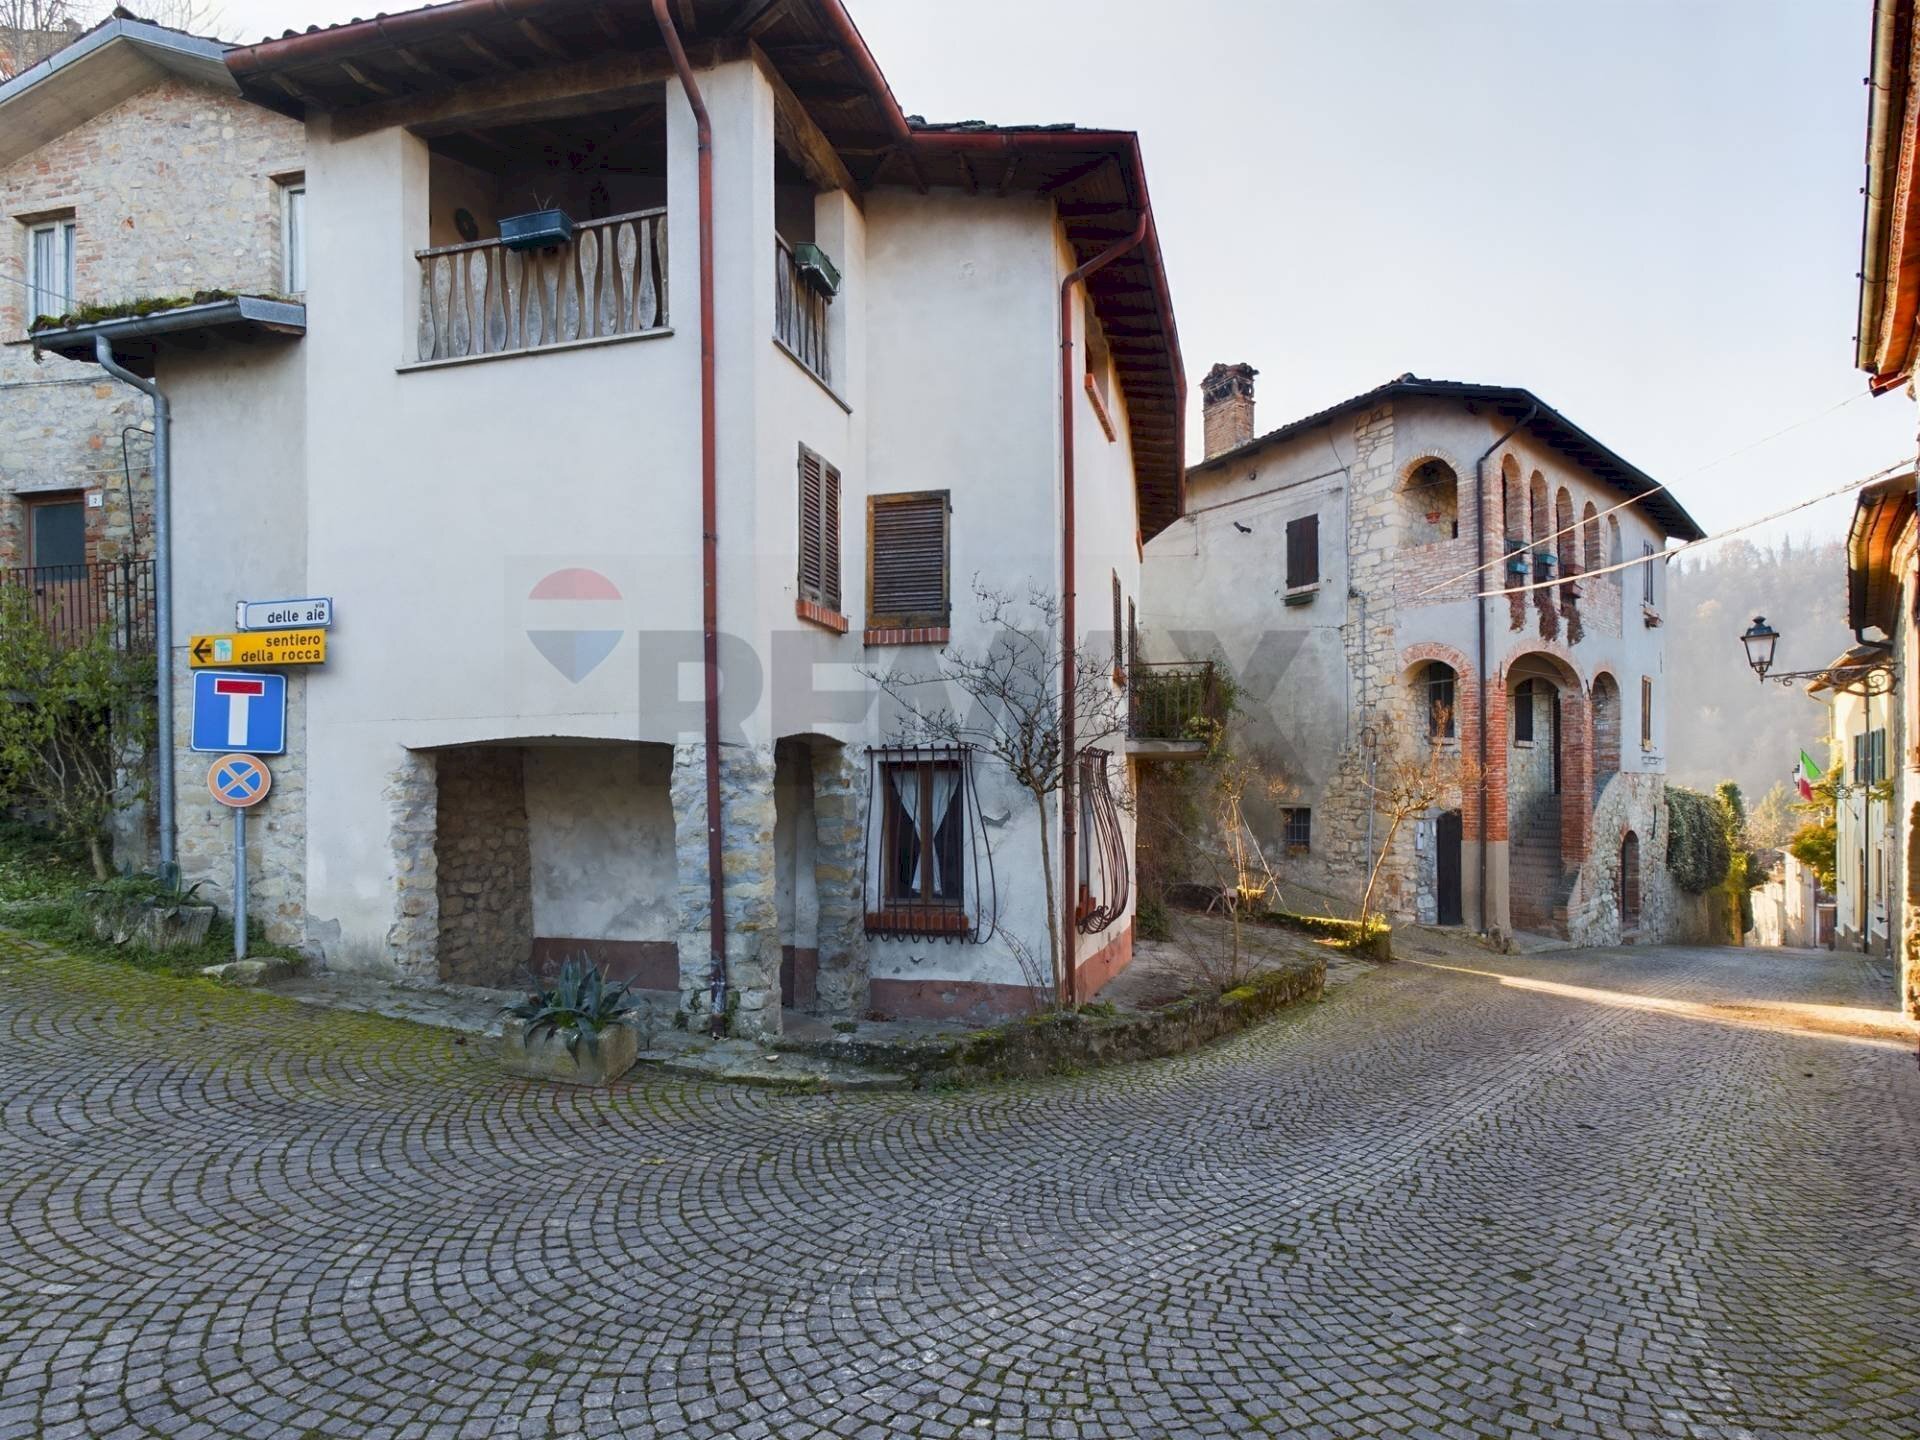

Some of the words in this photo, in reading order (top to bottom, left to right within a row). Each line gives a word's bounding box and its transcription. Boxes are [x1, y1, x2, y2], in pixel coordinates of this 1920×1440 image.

[267, 610, 299, 624] delle
[306, 609, 325, 621] aie
[266, 634, 321, 647] sentiero
[241, 651, 274, 662] della
[281, 648, 321, 660] rocca
